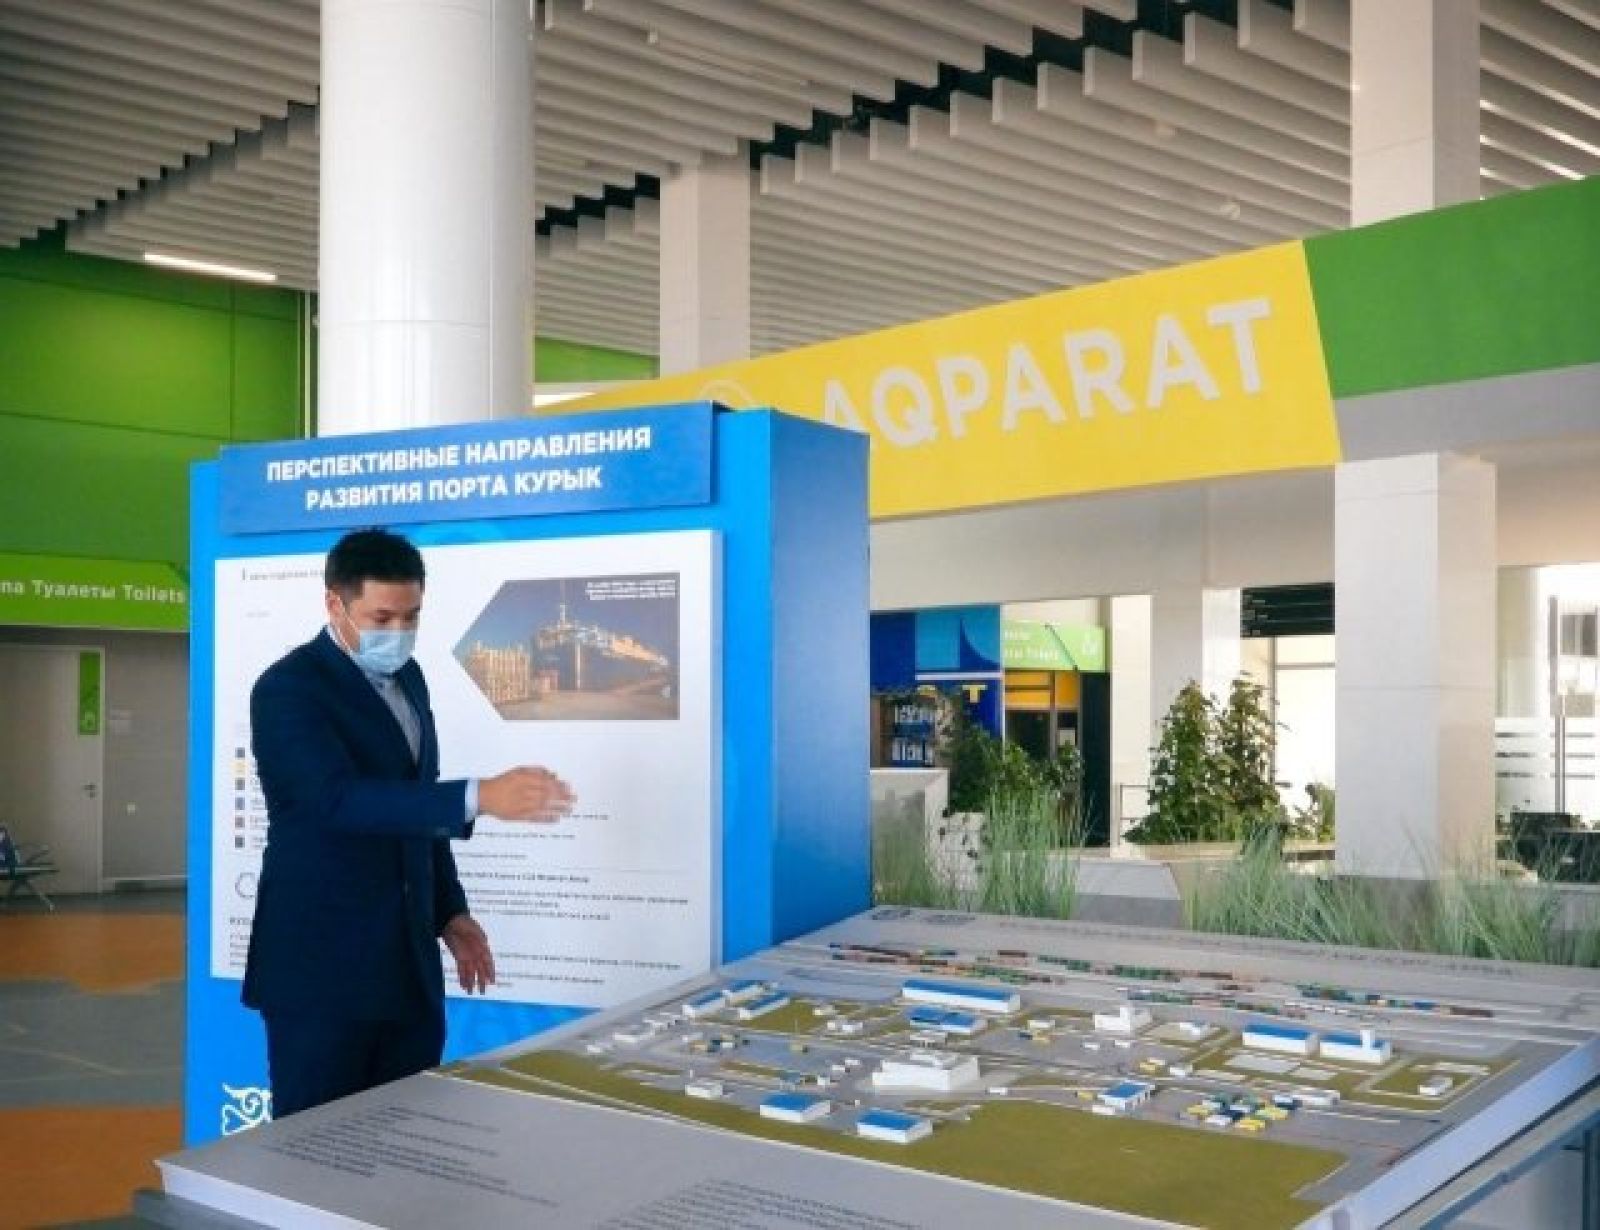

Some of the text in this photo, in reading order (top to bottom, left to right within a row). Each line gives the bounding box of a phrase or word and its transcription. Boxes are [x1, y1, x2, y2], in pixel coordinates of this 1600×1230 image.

[823, 299, 1270, 447] AQPARAT
[266, 427, 651, 481] ПЕРСПЕКТИВНЫЕ НАПРАВЛЕНИЯ
[306, 465, 602, 511] РАЗВИТИЯ ПОРТА КУРЫК
[32, 579, 116, 598] Туалеты
[122, 584, 186, 603] Toilets
